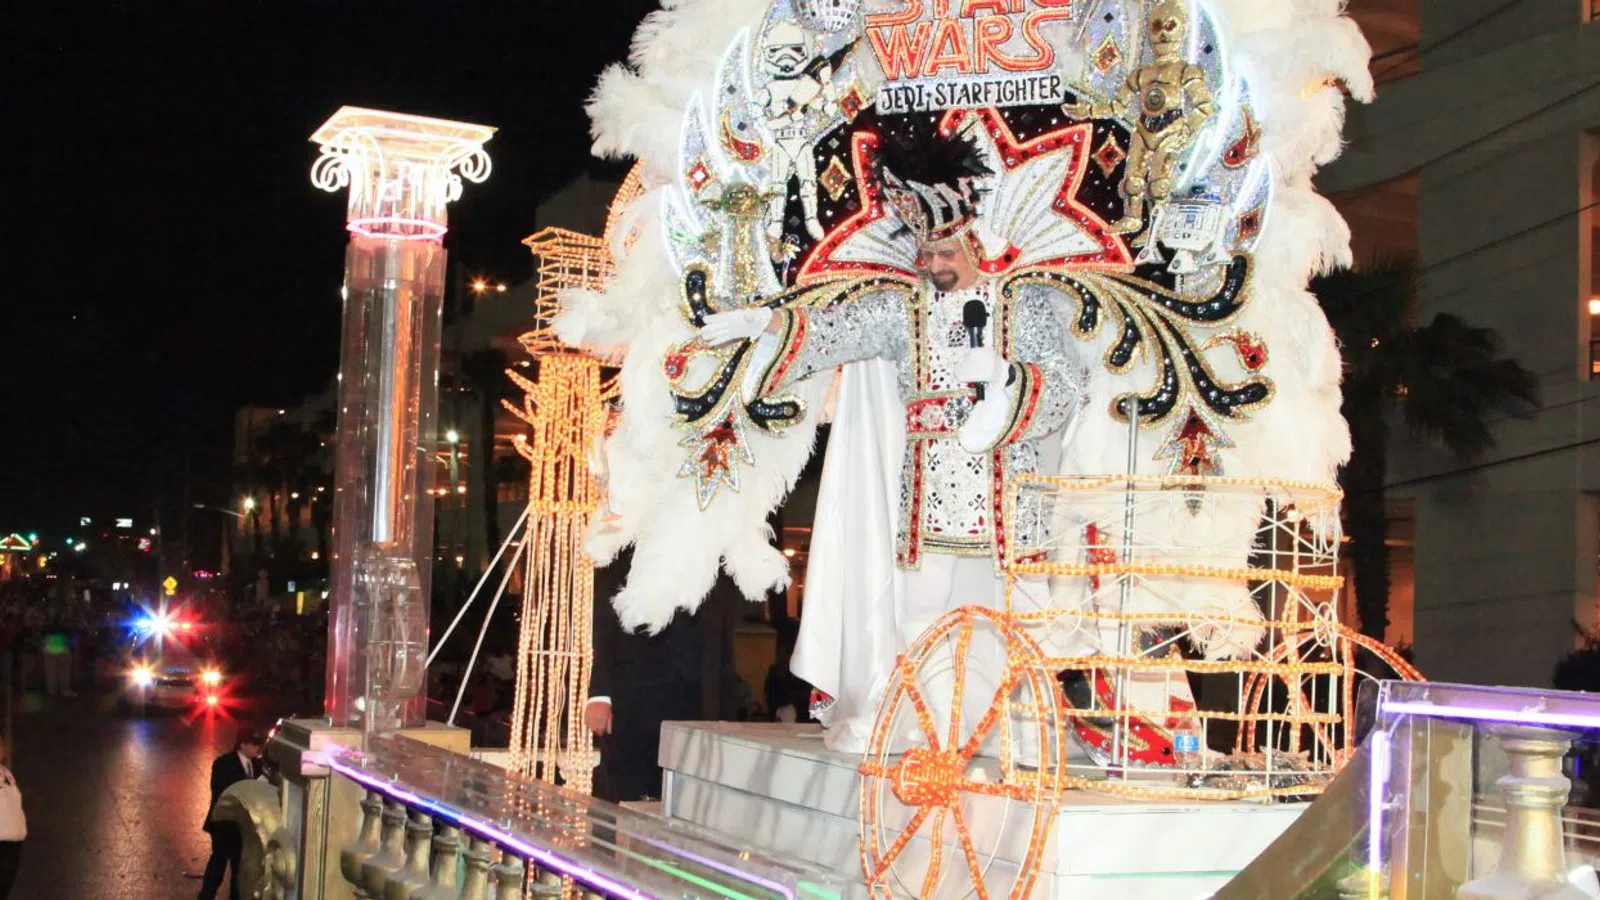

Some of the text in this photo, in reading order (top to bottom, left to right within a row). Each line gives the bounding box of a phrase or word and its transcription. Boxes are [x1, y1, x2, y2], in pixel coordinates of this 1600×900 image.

[866, 8, 1072, 80] WARS
[881, 75, 1061, 110] JEDI STARFIGHTER
